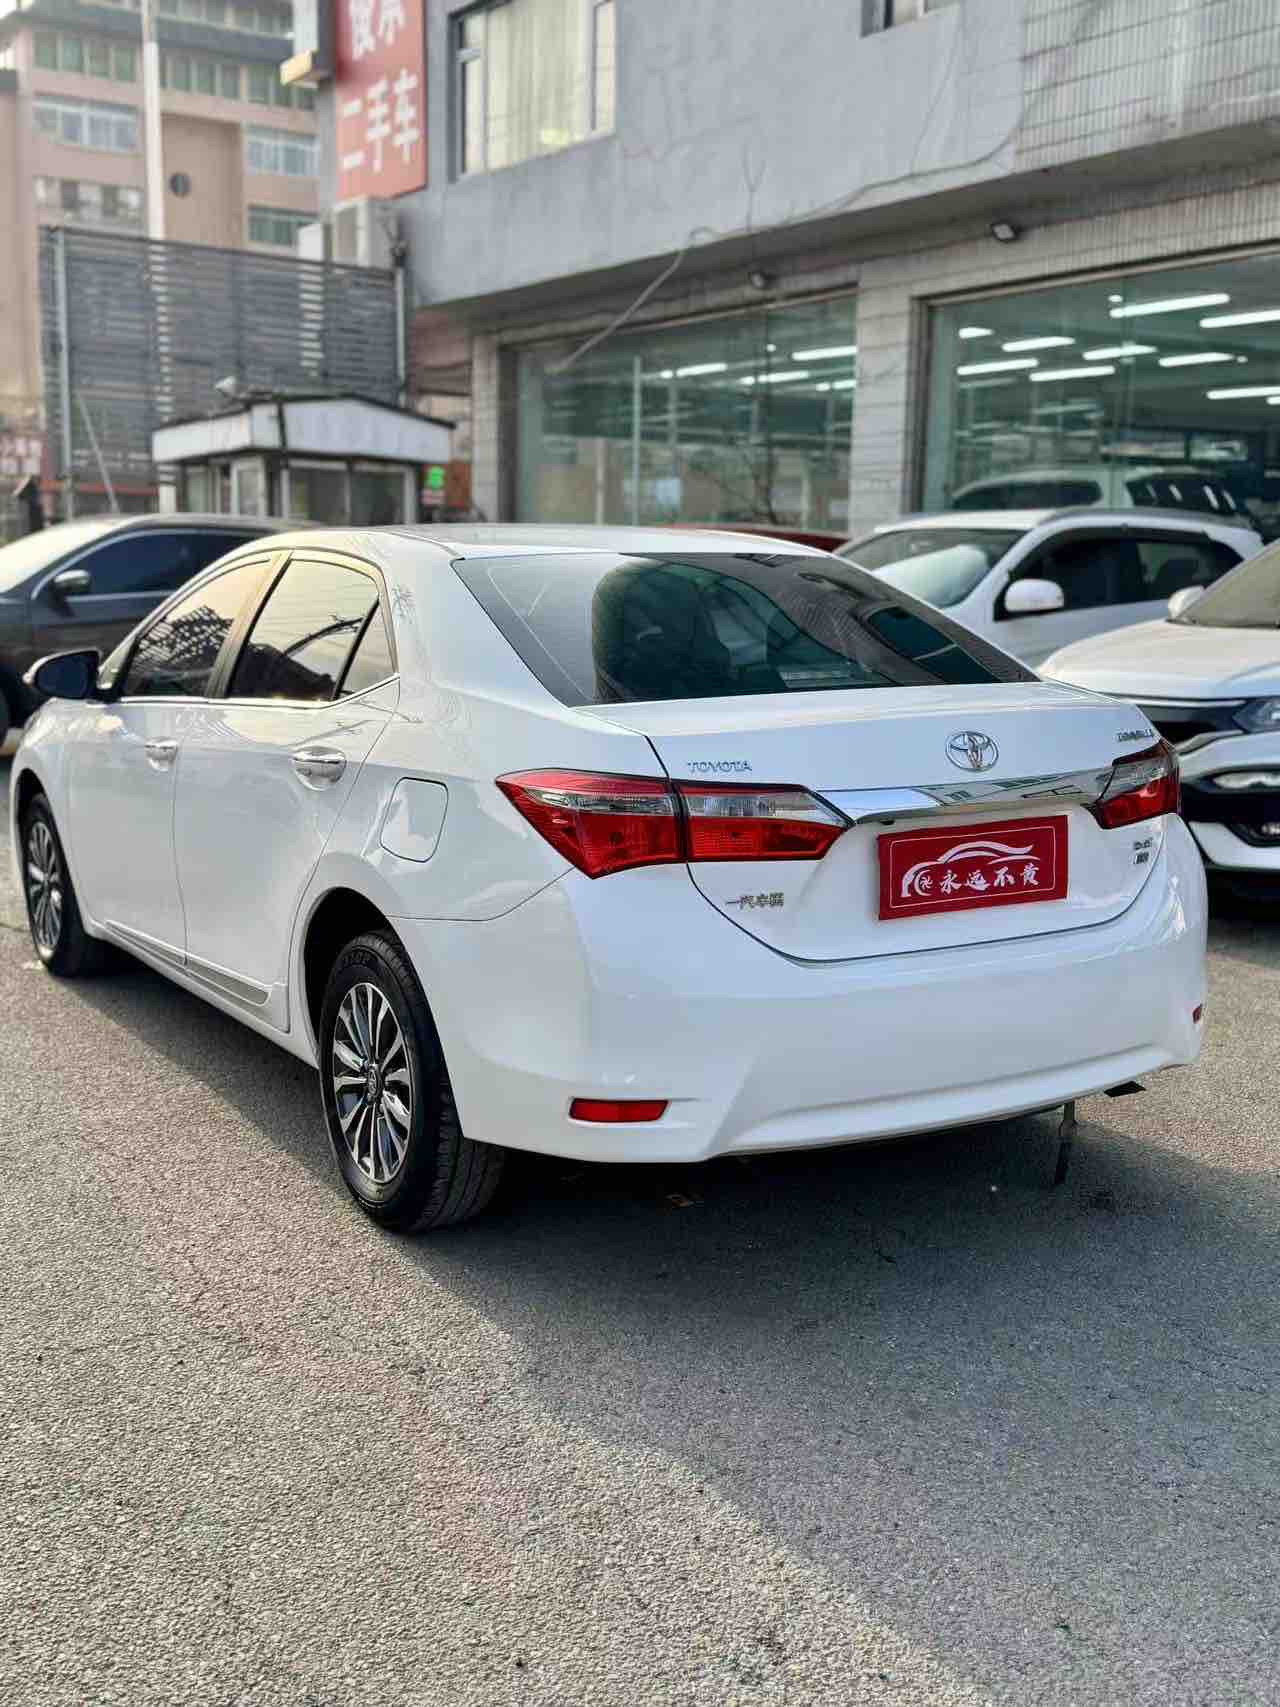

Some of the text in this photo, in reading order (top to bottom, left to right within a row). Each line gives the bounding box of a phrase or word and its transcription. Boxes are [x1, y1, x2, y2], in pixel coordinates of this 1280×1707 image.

[341, 67, 422, 173] 二手车
[687, 760, 752, 773] TOYOTA
